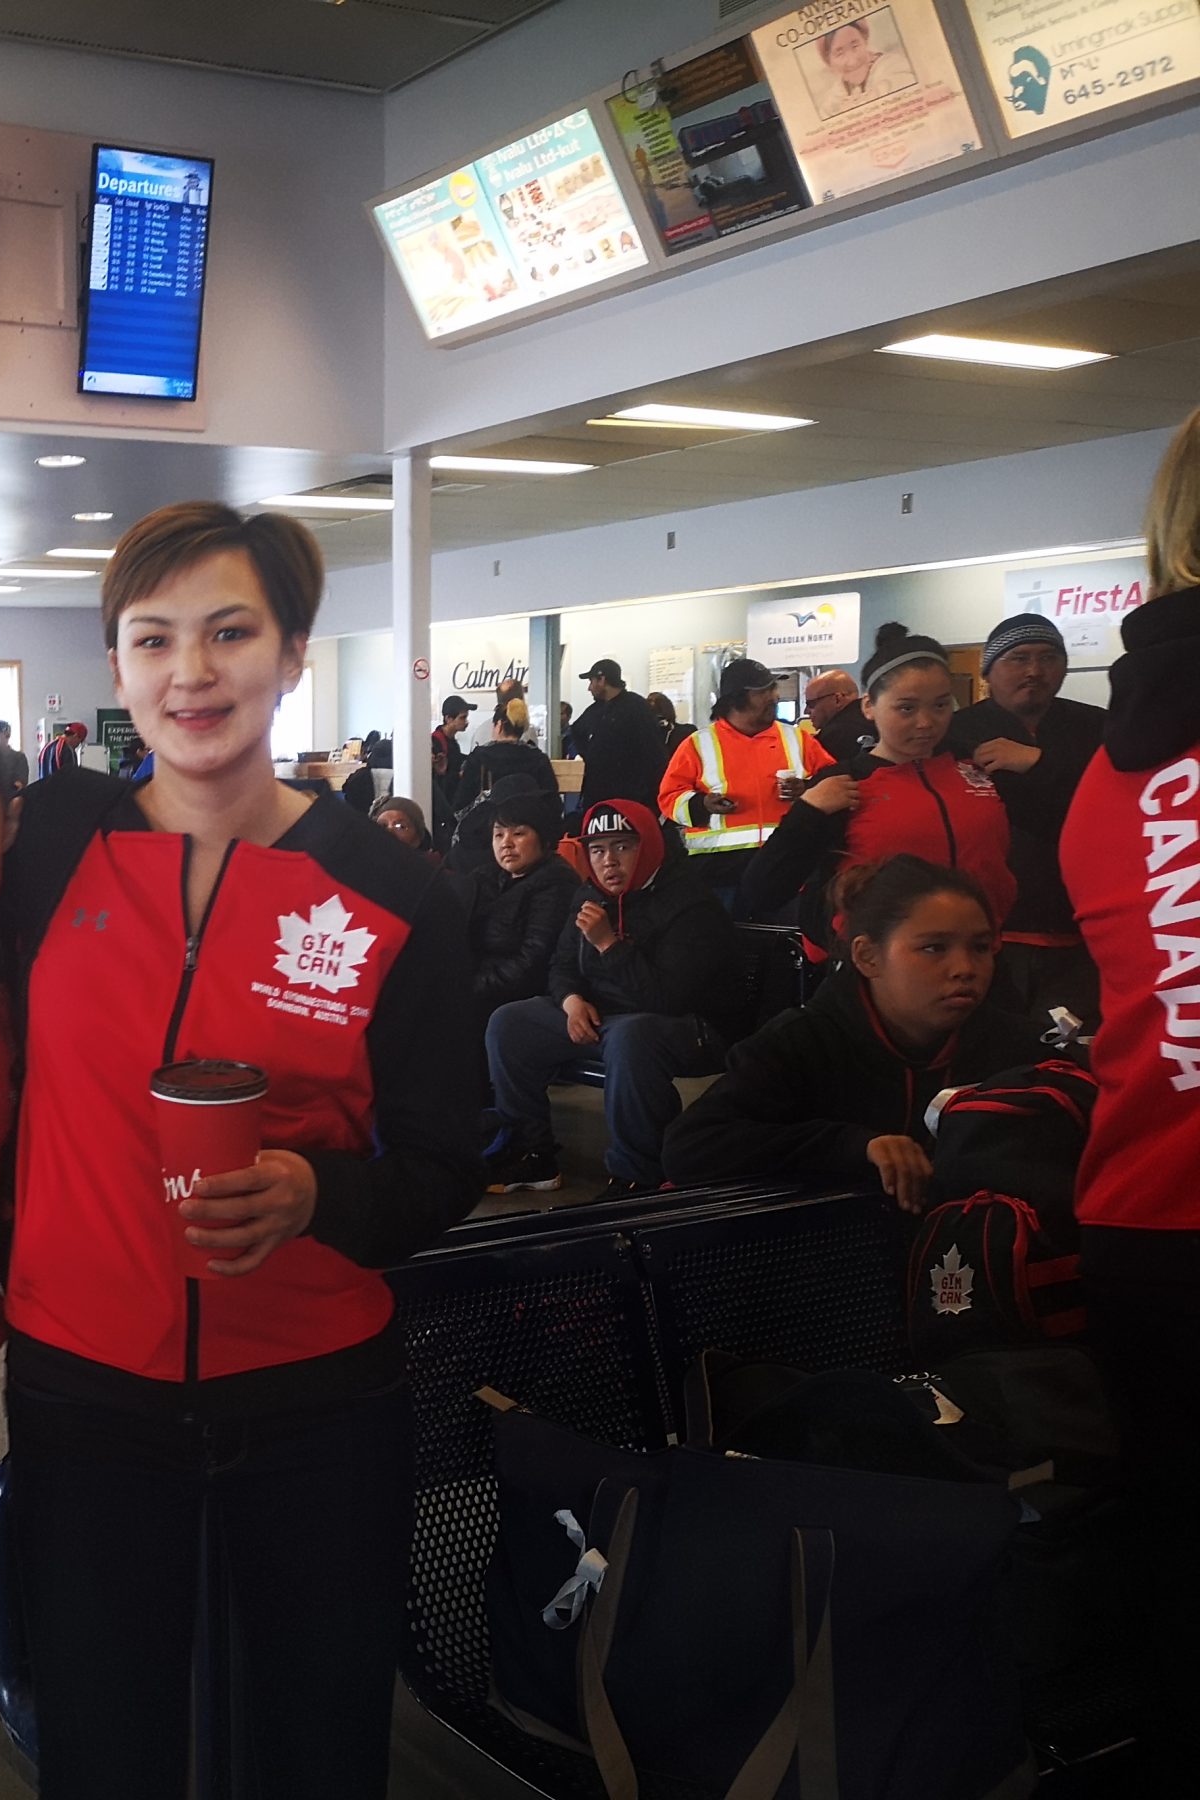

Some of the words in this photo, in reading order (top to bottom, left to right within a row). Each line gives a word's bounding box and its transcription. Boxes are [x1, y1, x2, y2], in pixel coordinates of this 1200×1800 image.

[1063, 55, 1175, 105] 645-2972
[1055, 580, 1144, 617] FirstA
[807, 633, 834, 642] NORTH
[452, 659, 501, 690] Calm
[501, 657, 529, 684] Air
[587, 813, 633, 835] INUK
[1139, 757, 1200, 1092] CANADA
[301, 932, 345, 957] GYM
[297, 953, 341, 977] CAN
[941, 1272, 962, 1290] GYM
[939, 1291, 962, 1305] CAN
